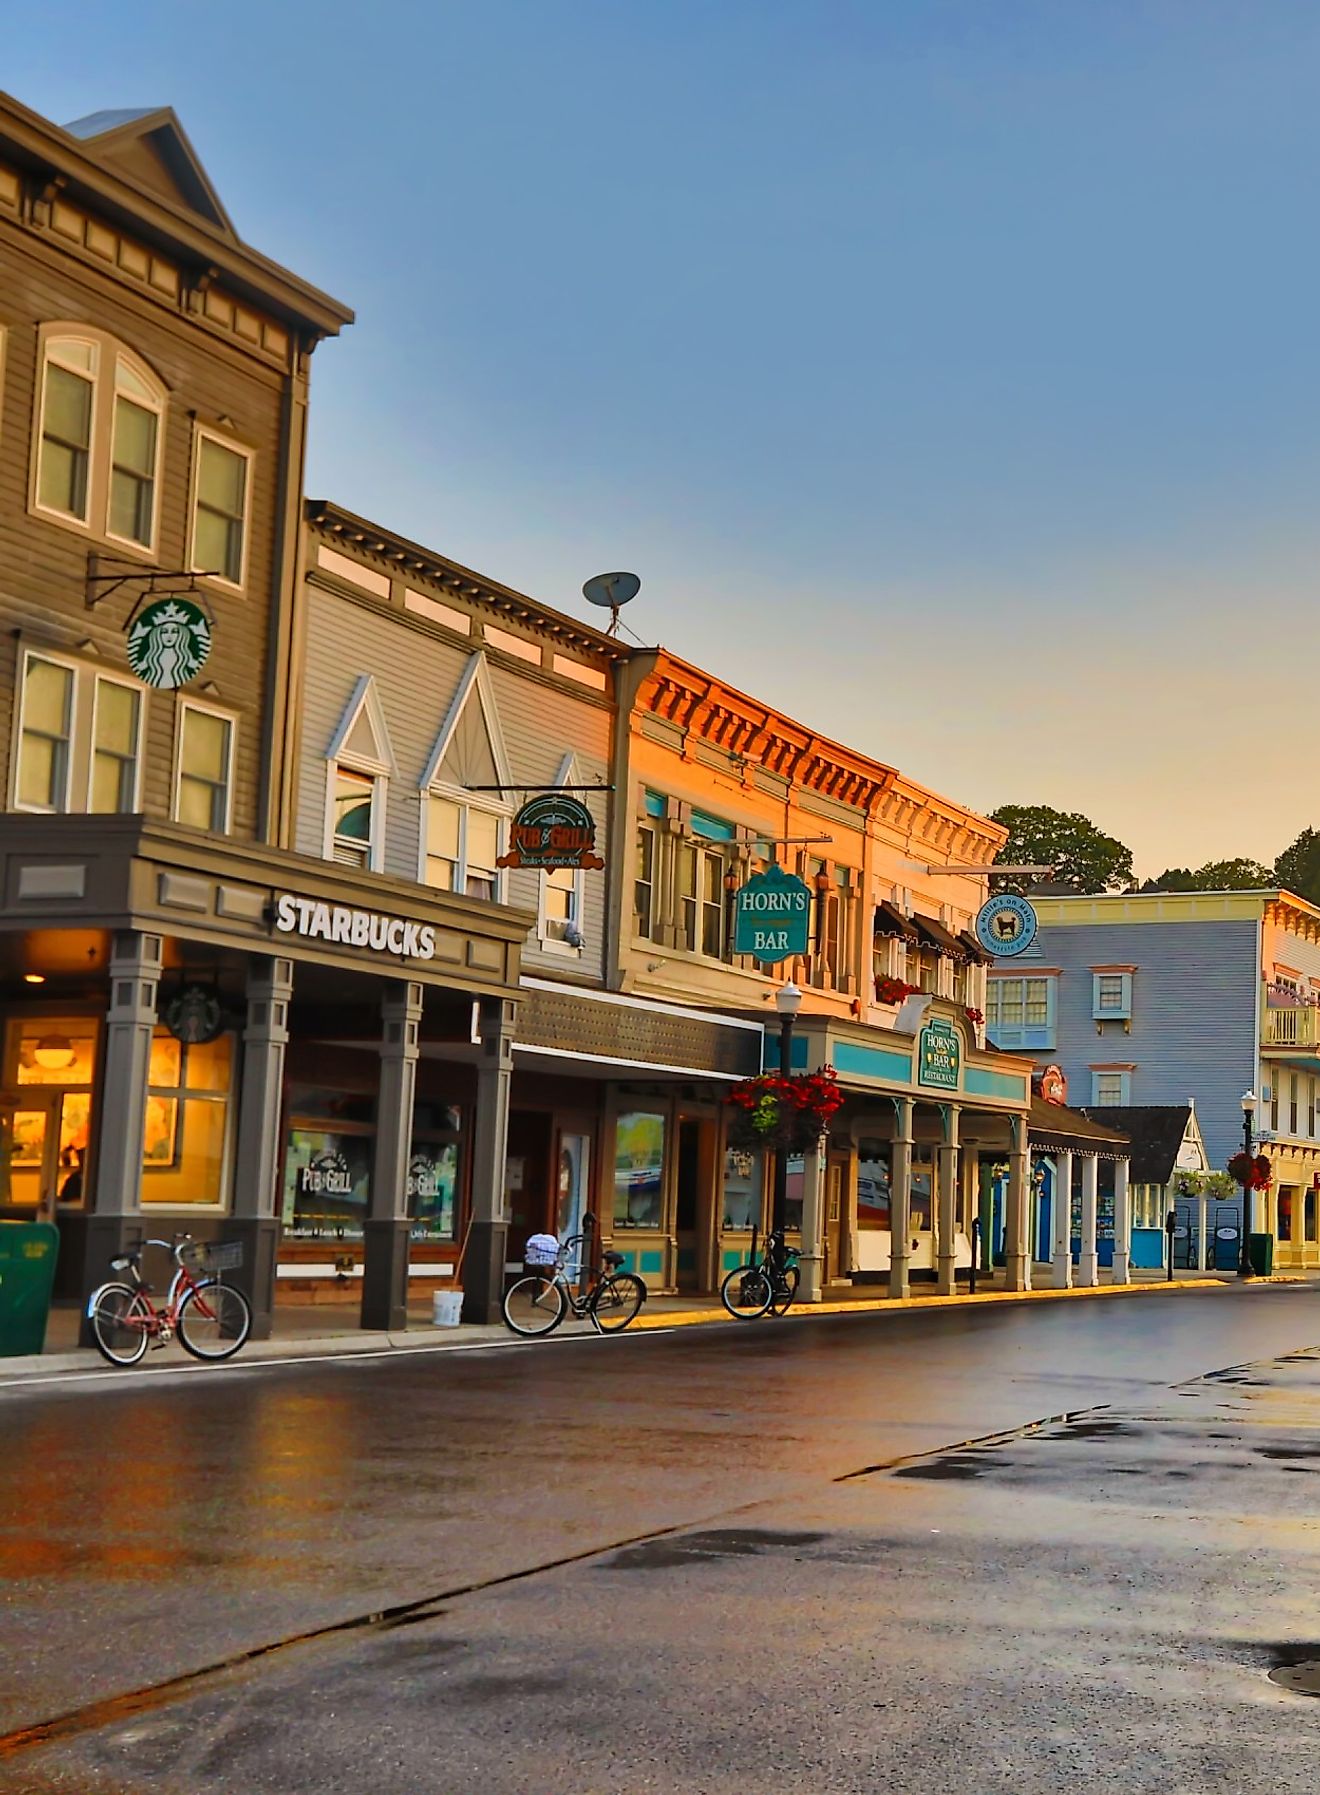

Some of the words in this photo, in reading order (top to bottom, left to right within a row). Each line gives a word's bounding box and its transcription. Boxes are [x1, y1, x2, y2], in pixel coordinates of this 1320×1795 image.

[510, 824, 540, 850] PUB
[551, 825, 594, 850] GRILL
[741, 892, 806, 911] HORN'S
[1019, 904, 1032, 923] Main
[276, 894, 436, 960] STARBUCKS
[754, 931, 789, 950] BAR
[927, 1034, 956, 1052] HORN'S
[933, 1053, 949, 1068] BAR
